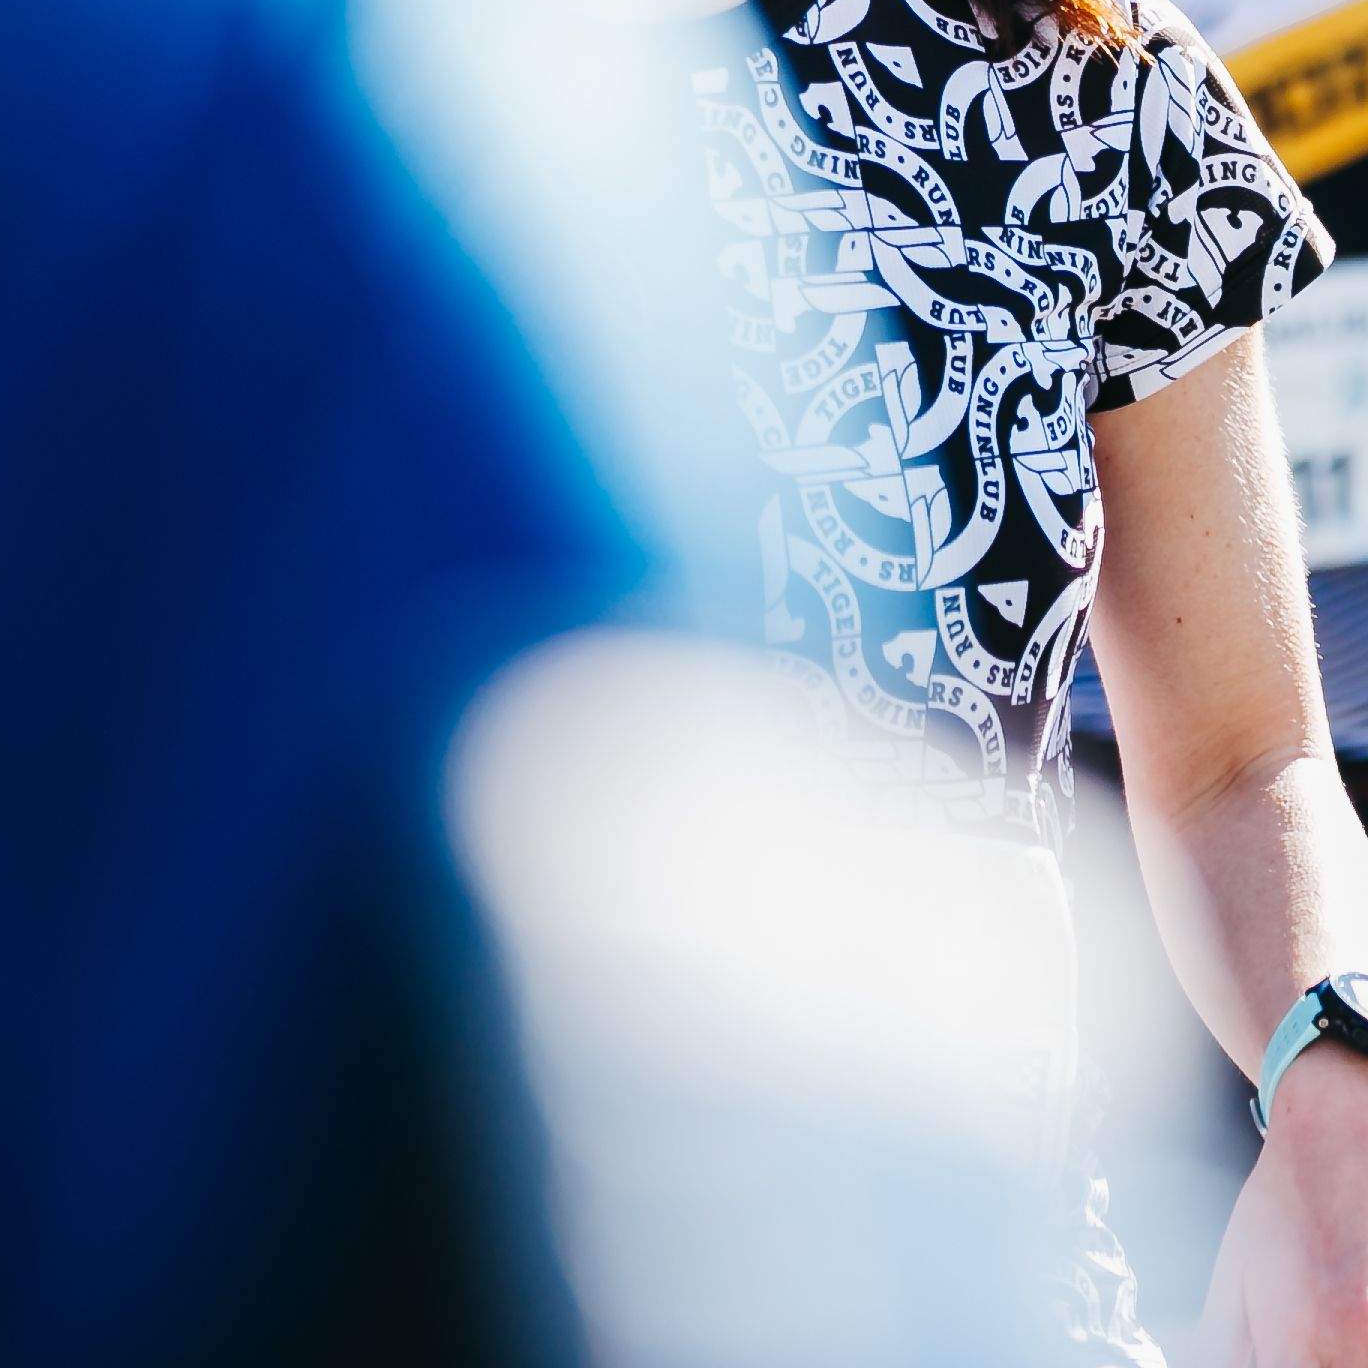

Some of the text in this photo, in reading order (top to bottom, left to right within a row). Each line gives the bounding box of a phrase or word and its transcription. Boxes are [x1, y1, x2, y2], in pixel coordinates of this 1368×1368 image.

[997, 40, 1052, 85] TIGE
[836, 46, 938, 144] RS RUN
[945, 103, 963, 161] LUB
[858, 132, 888, 160] RS
[912, 165, 958, 228] RUN
[967, 246, 996, 271] RS
[947, 332, 967, 395] LUB
[814, 370, 879, 422] TIGE
[942, 595, 974, 658] RUN
[931, 681, 965, 708] RS
